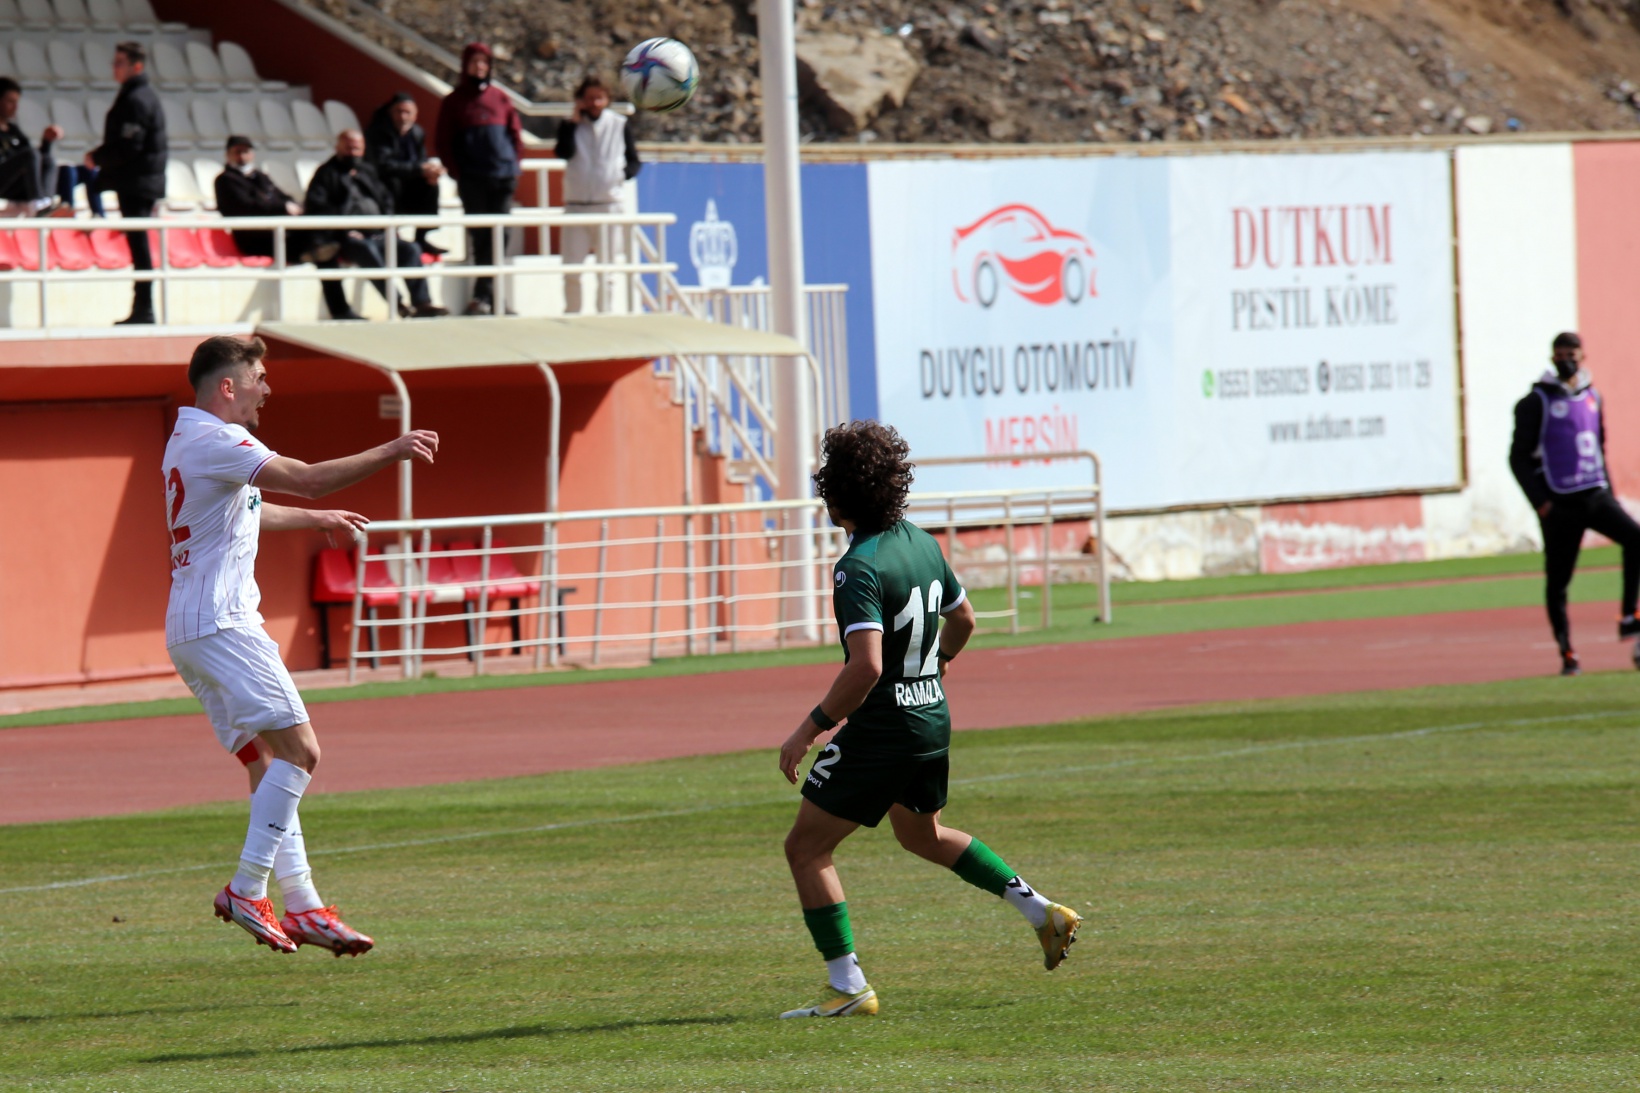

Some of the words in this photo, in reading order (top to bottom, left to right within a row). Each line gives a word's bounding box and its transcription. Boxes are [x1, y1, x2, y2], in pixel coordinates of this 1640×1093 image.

[1231, 204, 1393, 269] DUTKUM
[1231, 275, 1319, 331] PESTİL
[1325, 273, 1398, 327] KÖME
[920, 346, 1005, 399] DUYGU
[1013, 328, 1136, 394] OTOMOTİV
[985, 404, 1079, 469] MERSİN
[894, 579, 943, 678] 12
[813, 743, 842, 780] 2
